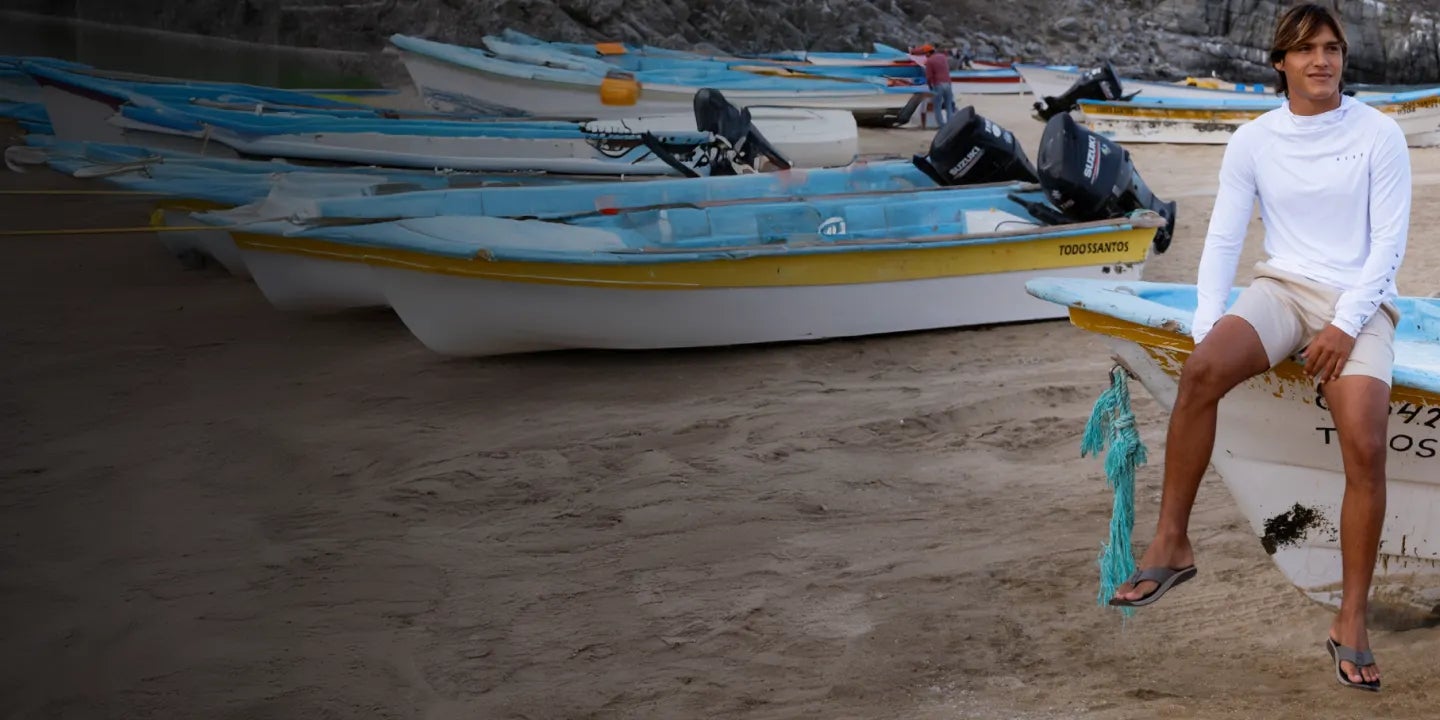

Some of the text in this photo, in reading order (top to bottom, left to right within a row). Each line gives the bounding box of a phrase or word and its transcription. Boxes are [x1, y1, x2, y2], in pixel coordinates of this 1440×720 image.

[949, 145, 981, 176] SUZUKI
[1083, 134, 1097, 179] SUZUKI
[1315, 426, 1438, 459] TOS
